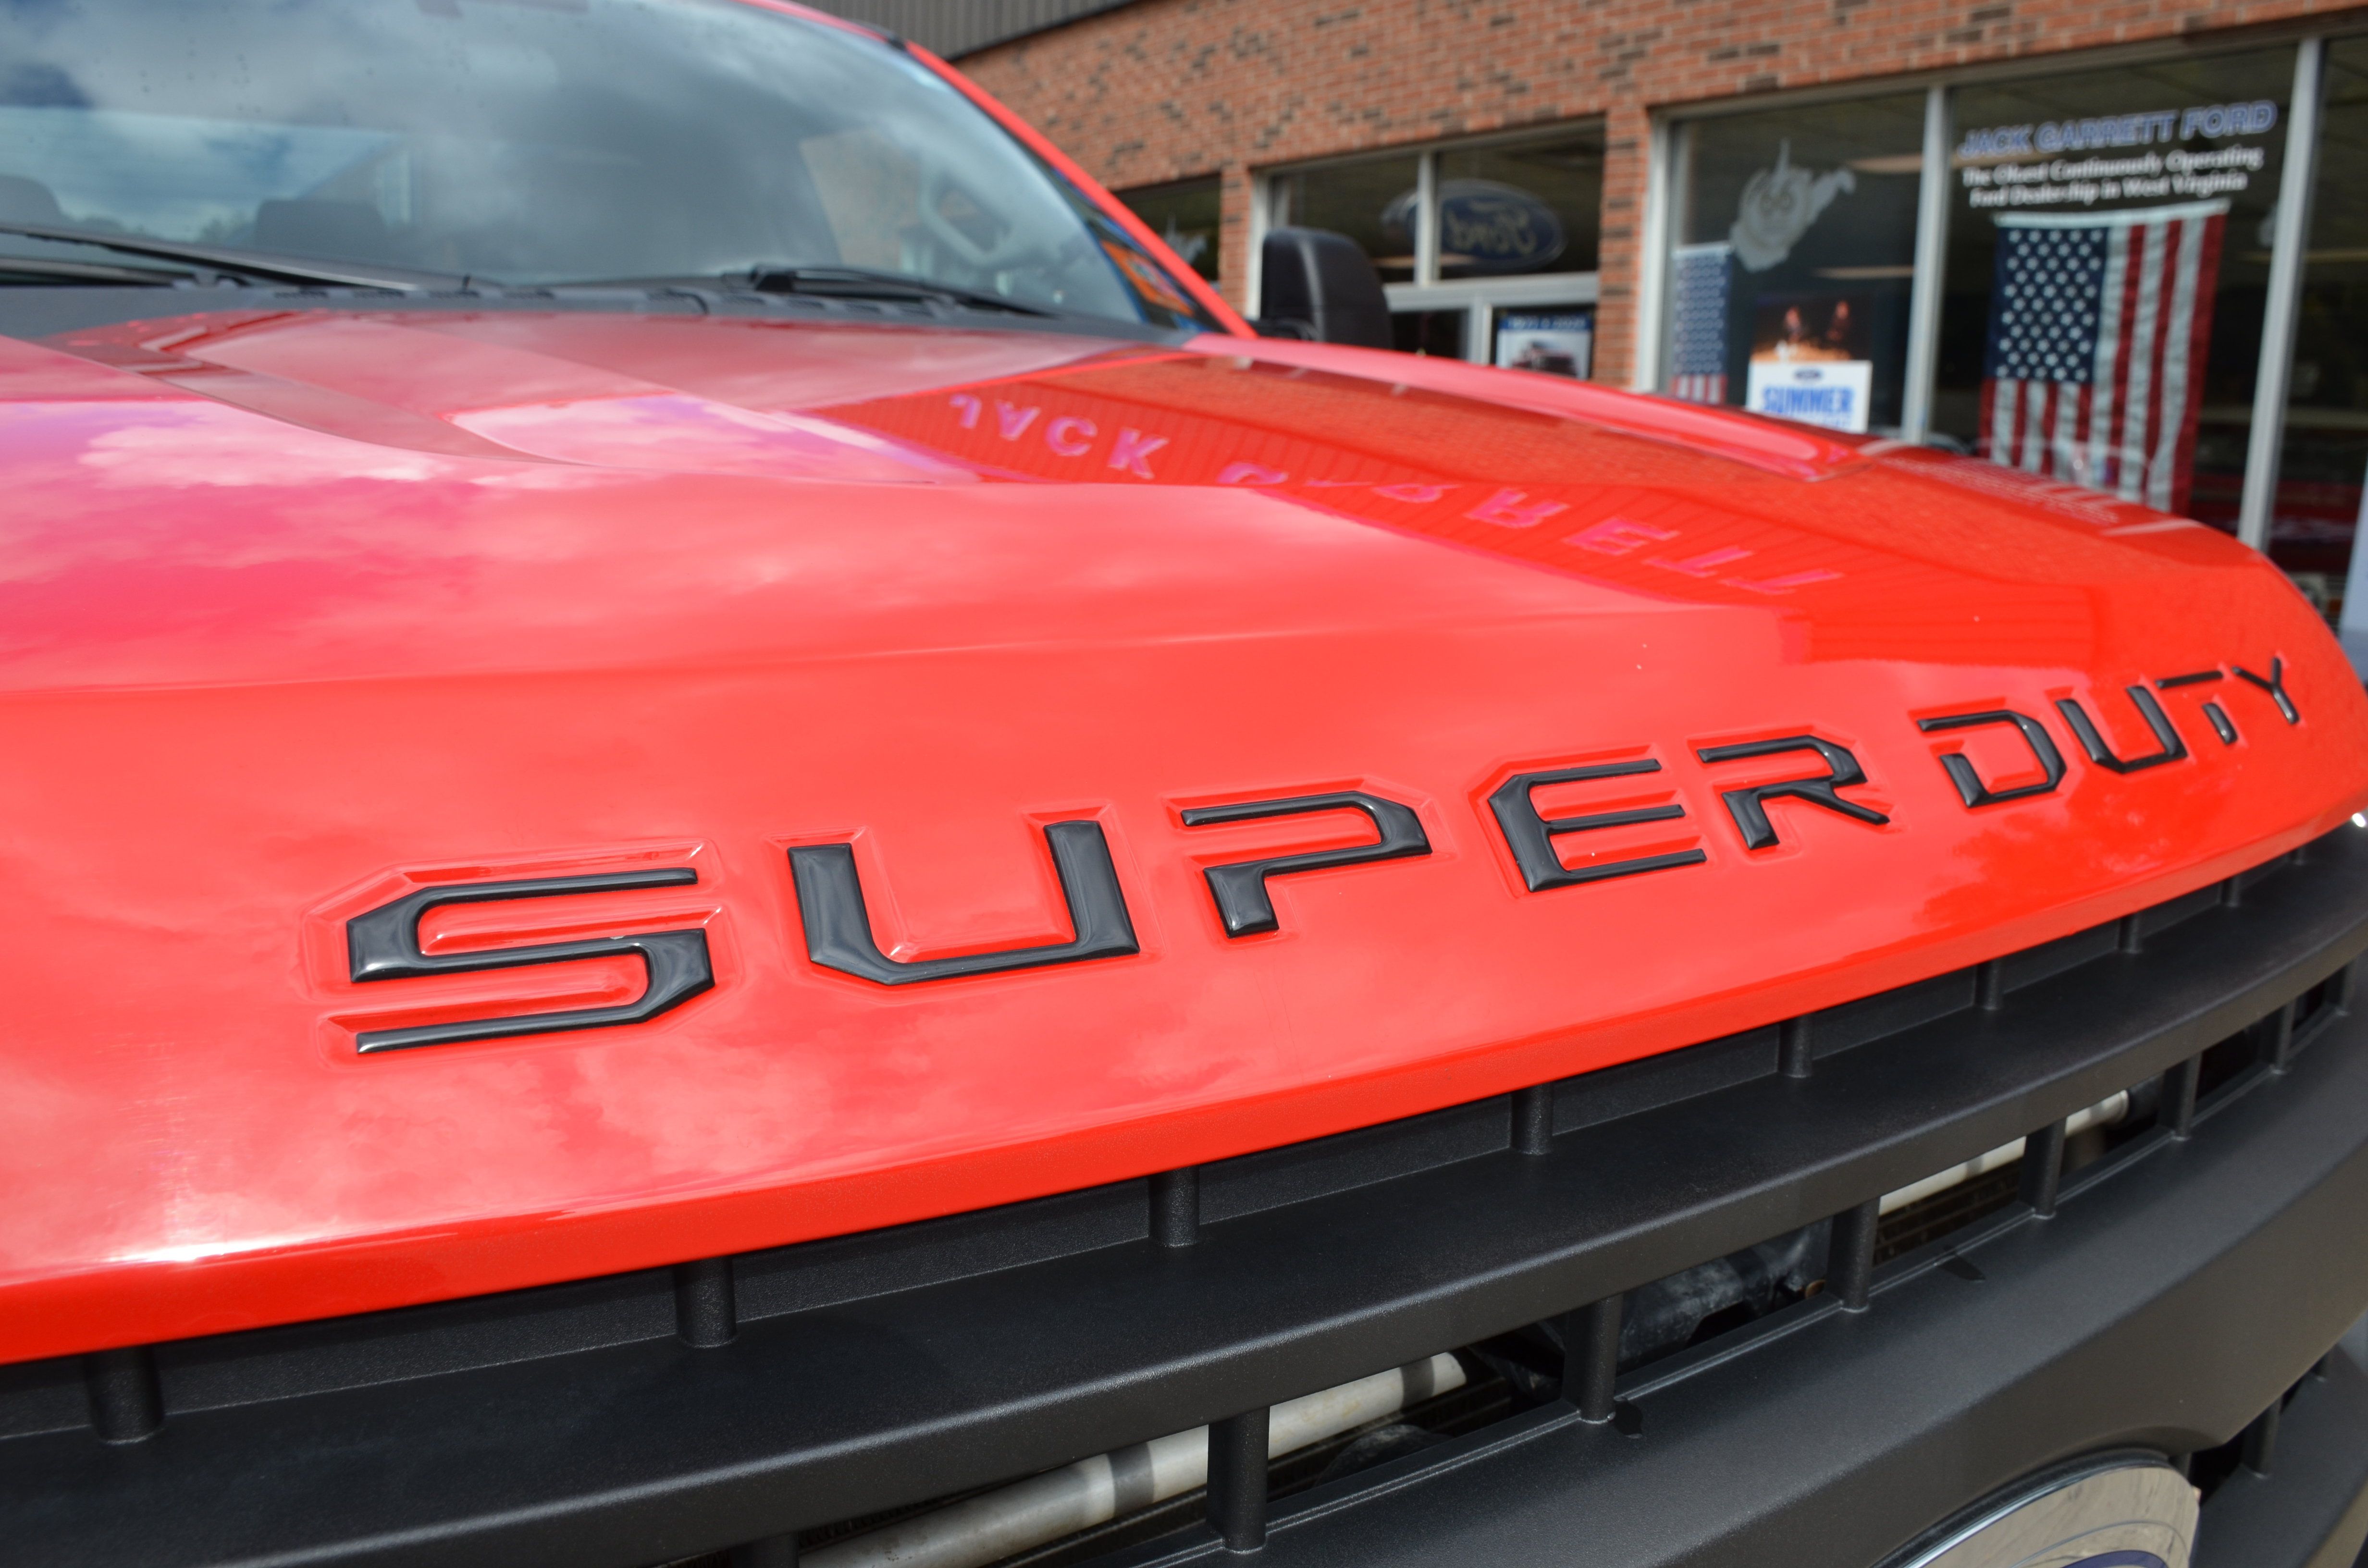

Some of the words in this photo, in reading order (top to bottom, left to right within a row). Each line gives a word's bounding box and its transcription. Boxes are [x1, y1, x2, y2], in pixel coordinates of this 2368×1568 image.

[1958, 124, 2035, 160] JACK
[2034, 109, 2179, 154] GARRETT
[2180, 100, 2278, 140] FORD
[1963, 167, 1992, 187] The
[2049, 151, 2162, 181] Continuously
[2165, 144, 2264, 176] Operating
[1970, 185, 2010, 208] Ford
[2010, 179, 2100, 206] Dealership
[2100, 178, 2121, 199] in
[2121, 174, 2171, 198] West
[2171, 170, 2248, 198] Virginia
[1763, 384, 1855, 416] SUMMER
[345, 732, 1890, 1055] SUPER
[1915, 656, 2300, 808] DUTY
